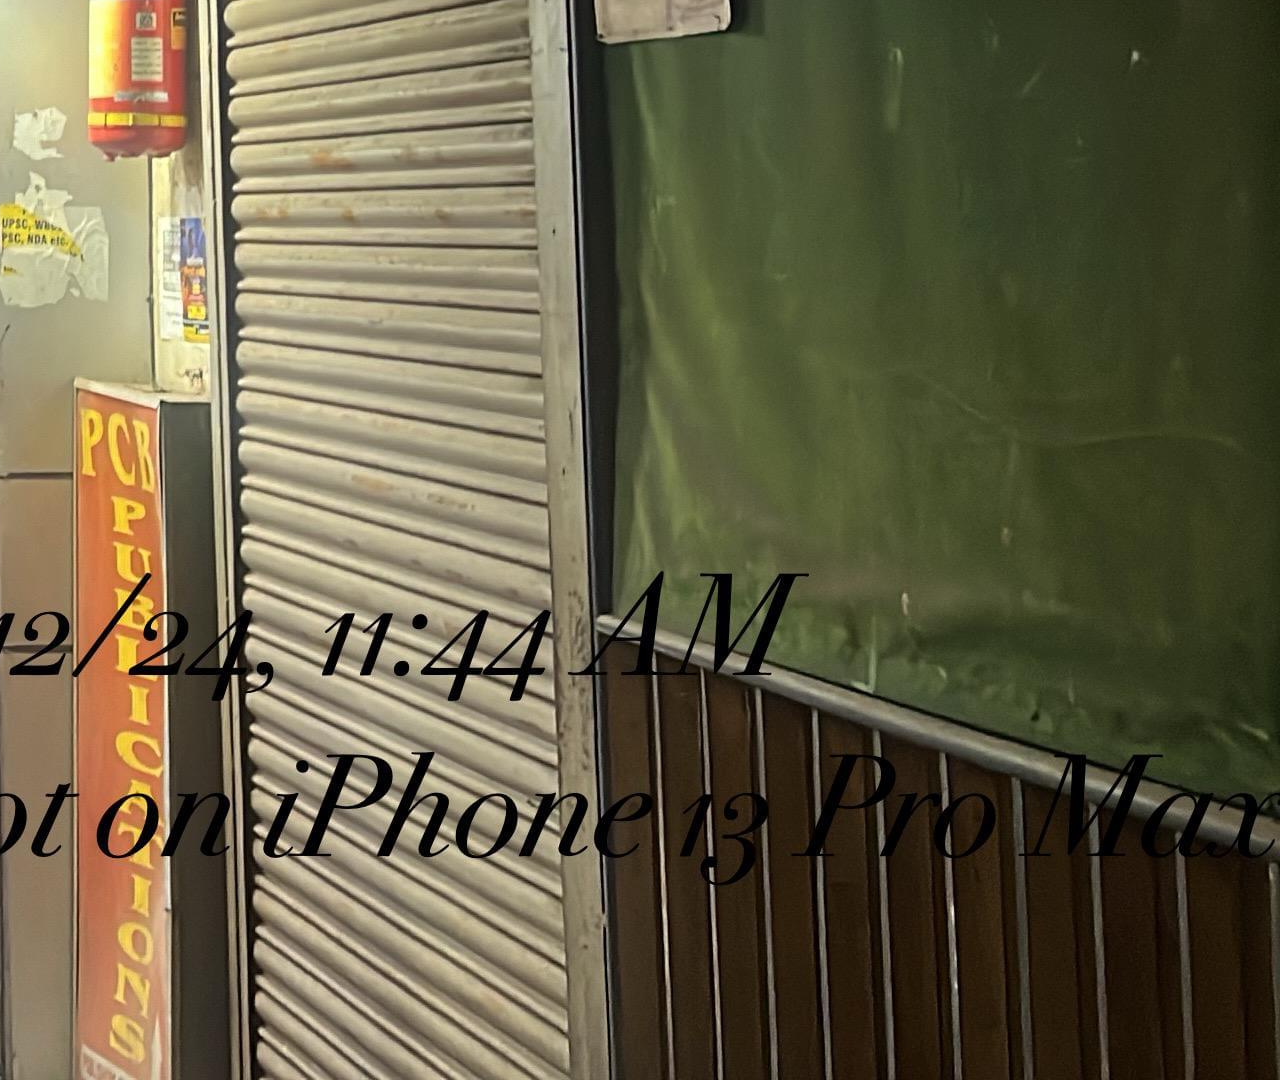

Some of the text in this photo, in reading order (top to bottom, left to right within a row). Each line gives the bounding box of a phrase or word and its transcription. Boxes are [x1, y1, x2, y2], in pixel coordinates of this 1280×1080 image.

[2, 218, 32, 232] UPSC,
[2, 232, 24, 245] PSC,
[27, 234, 47, 245] NDA
[80, 408, 156, 494] PCB
